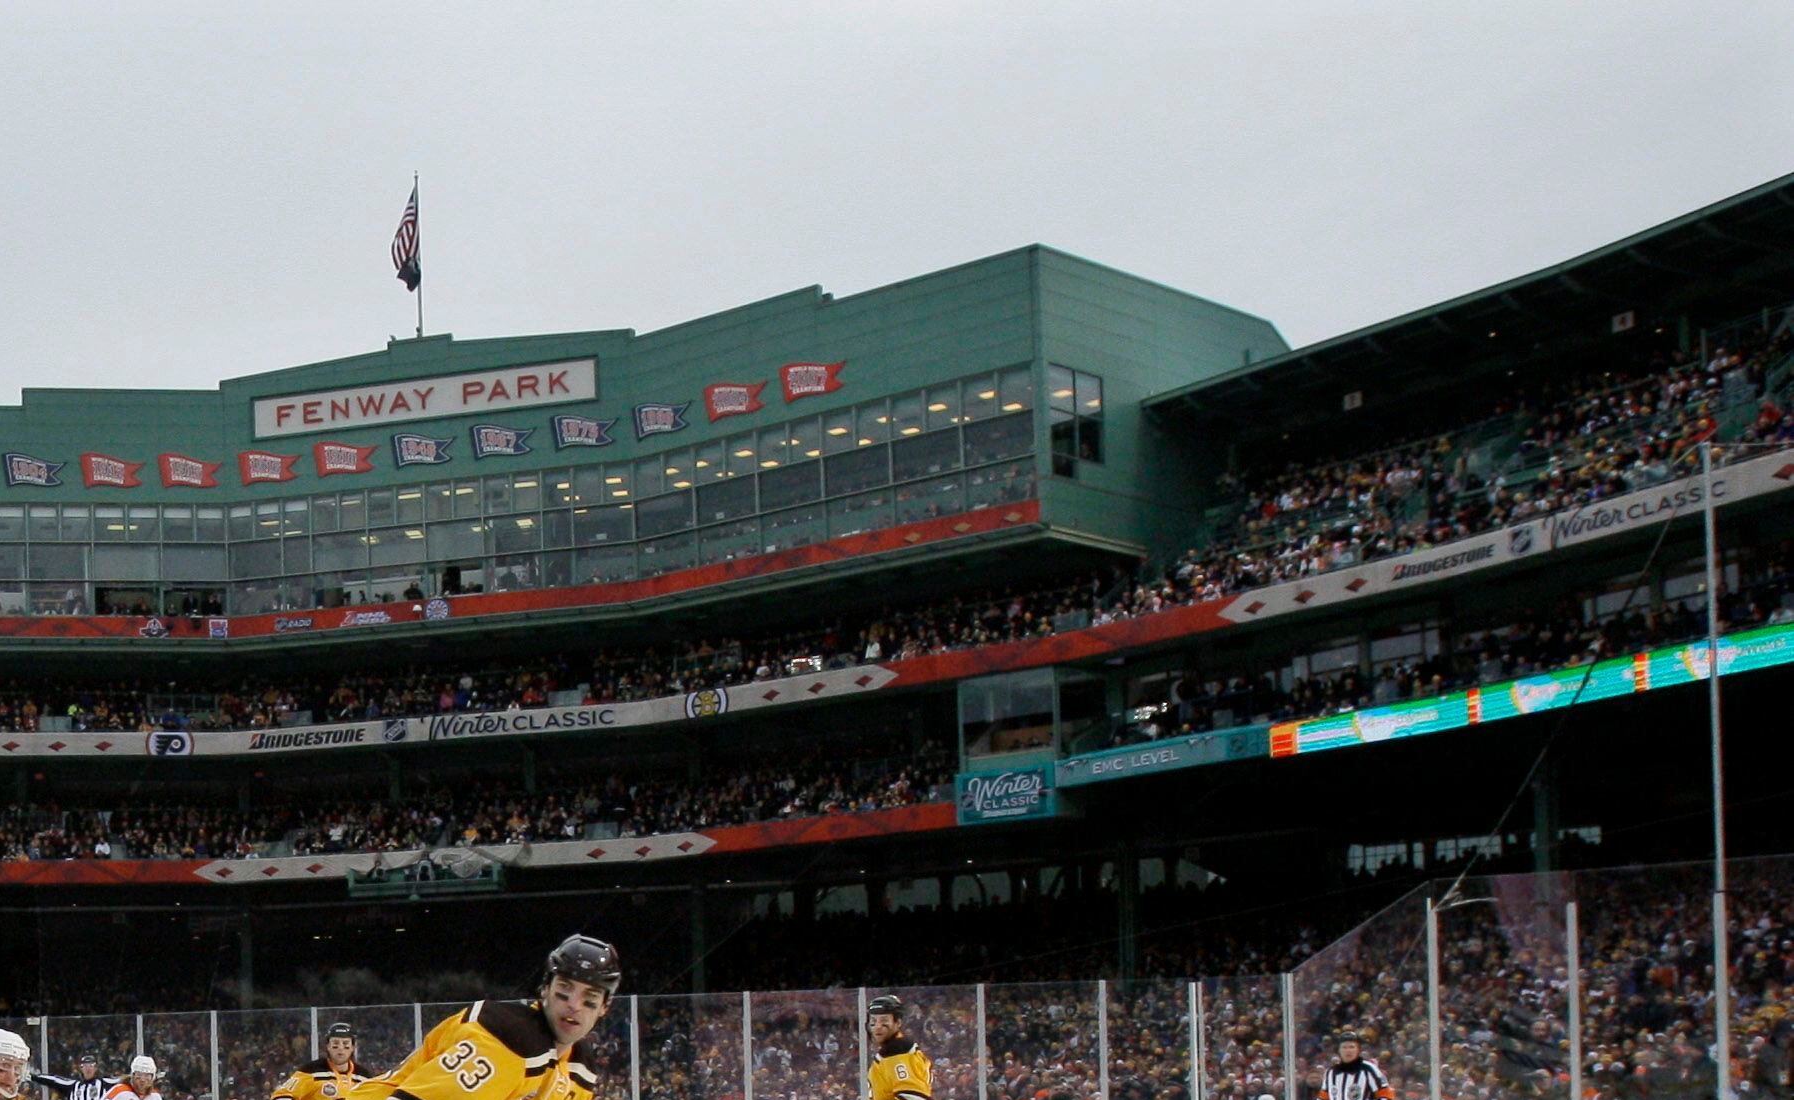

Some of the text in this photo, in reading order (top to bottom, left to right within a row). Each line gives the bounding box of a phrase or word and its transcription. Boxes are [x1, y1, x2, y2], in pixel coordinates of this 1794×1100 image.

[277, 371, 571, 428] FENWAY PARK
[1391, 544, 1494, 581] BRIDGESTONE
[1542, 508, 1625, 547] Winter
[1627, 481, 1726, 519] CLASSC
[249, 728, 365, 750] BRIDGESTONE
[421, 714, 507, 741] Winter
[513, 709, 615, 731] CLASSIC
[1093, 750, 1180, 774] EMC LEVEL
[969, 771, 1042, 811] Winter
[983, 795, 1039, 810] CLASSIC
[439, 1039, 495, 1092] 33
